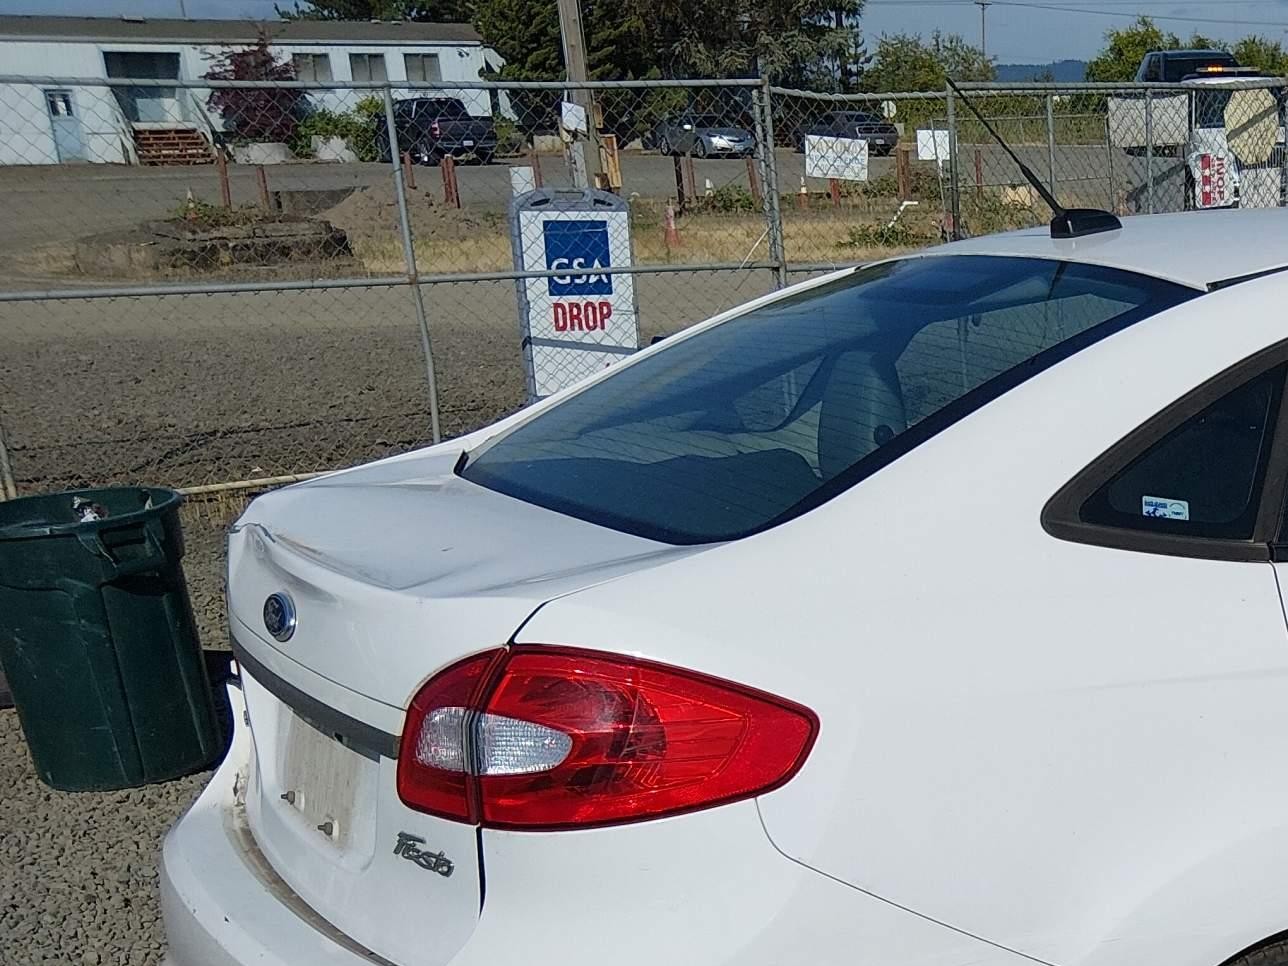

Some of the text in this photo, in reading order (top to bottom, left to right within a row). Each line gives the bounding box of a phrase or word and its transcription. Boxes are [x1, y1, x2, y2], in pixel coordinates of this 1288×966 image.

[1215, 156, 1225, 200] INOP
[550, 257, 609, 285] GSA
[552, 301, 613, 332] DROP
[393, 831, 455, 877] Fiesta
